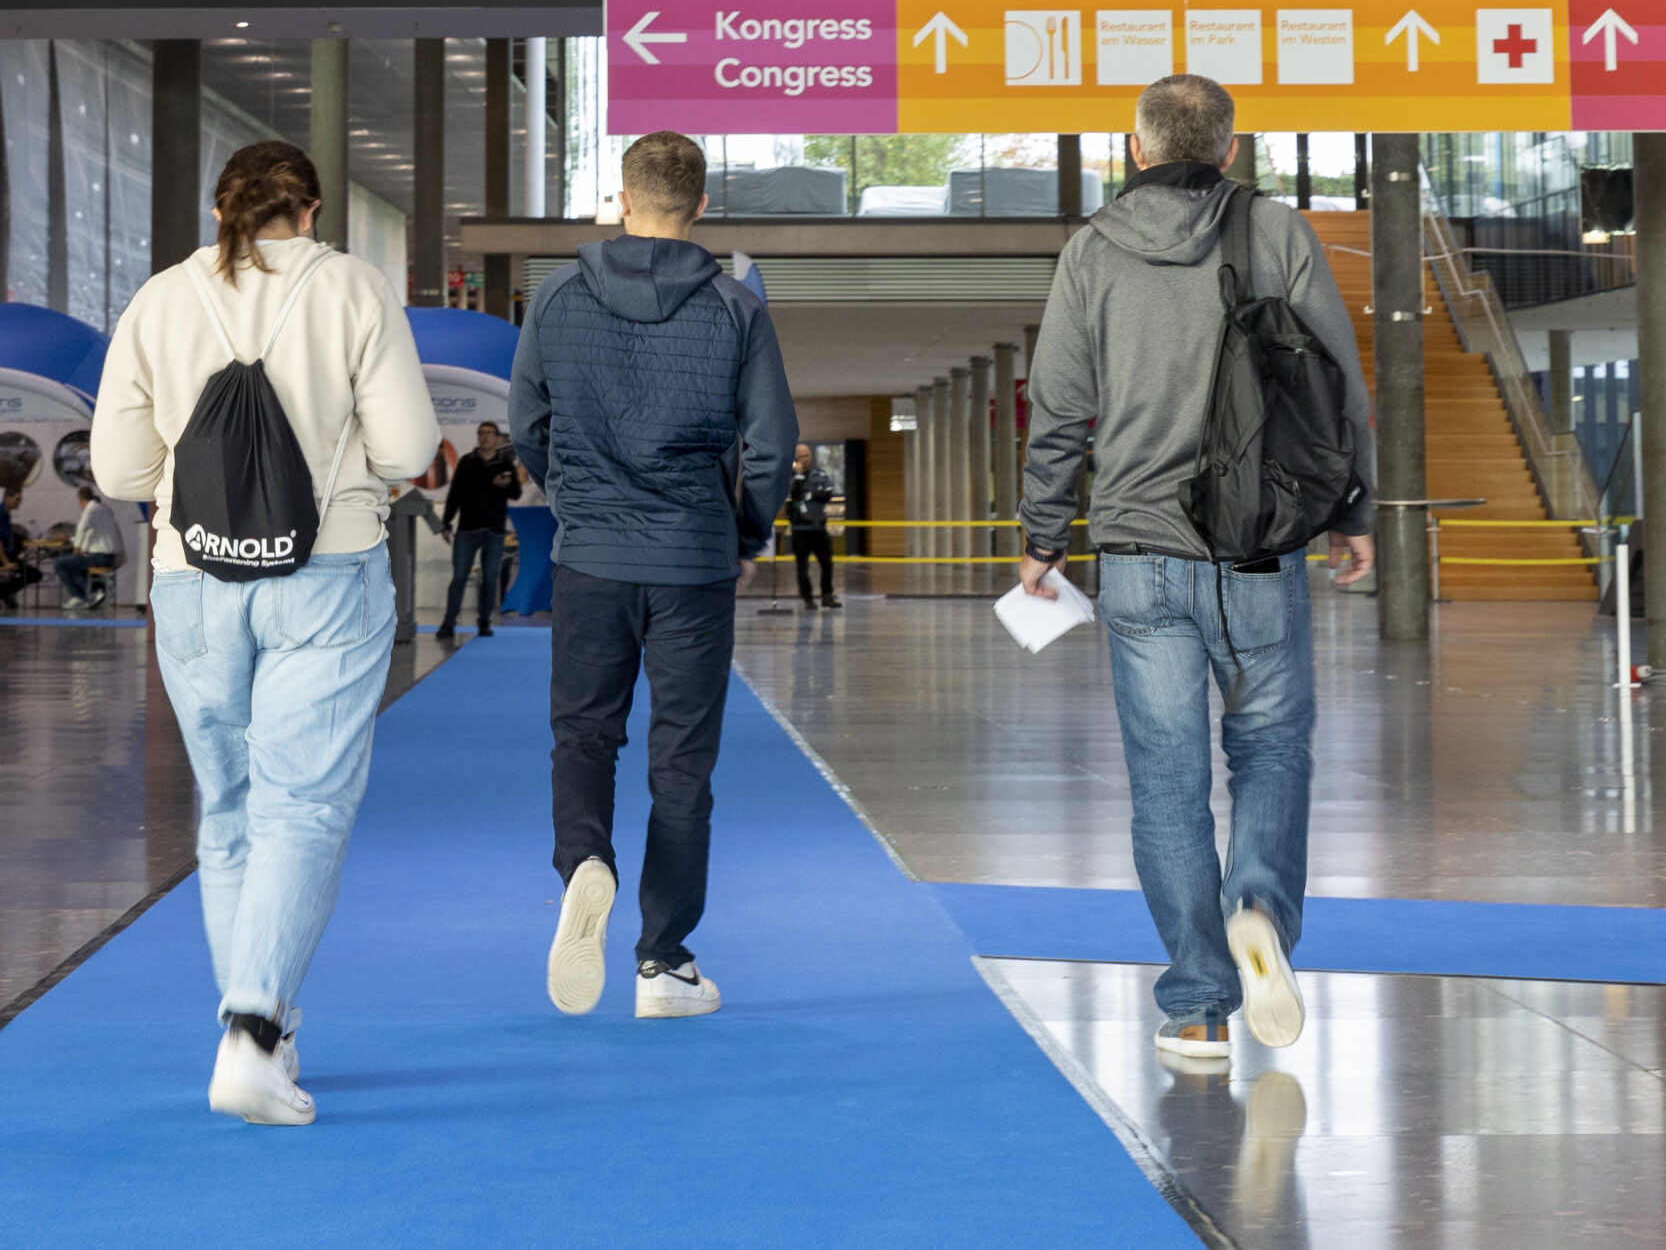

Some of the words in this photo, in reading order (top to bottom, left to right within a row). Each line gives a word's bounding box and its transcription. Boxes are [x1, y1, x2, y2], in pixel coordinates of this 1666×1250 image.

[715, 11, 873, 49] Kongress
[1100, 20, 1166, 32] Restaurant
[1189, 19, 1256, 31] Restaurant
[1280, 19, 1347, 31] Restaurant
[1101, 37, 1119, 46] am
[1122, 34, 1167, 46] Wasser
[1190, 35, 1205, 45] im
[1208, 33, 1236, 46] Park
[1281, 35, 1296, 45] im
[1299, 33, 1347, 45] Westen
[714, 57, 873, 96] Congress
